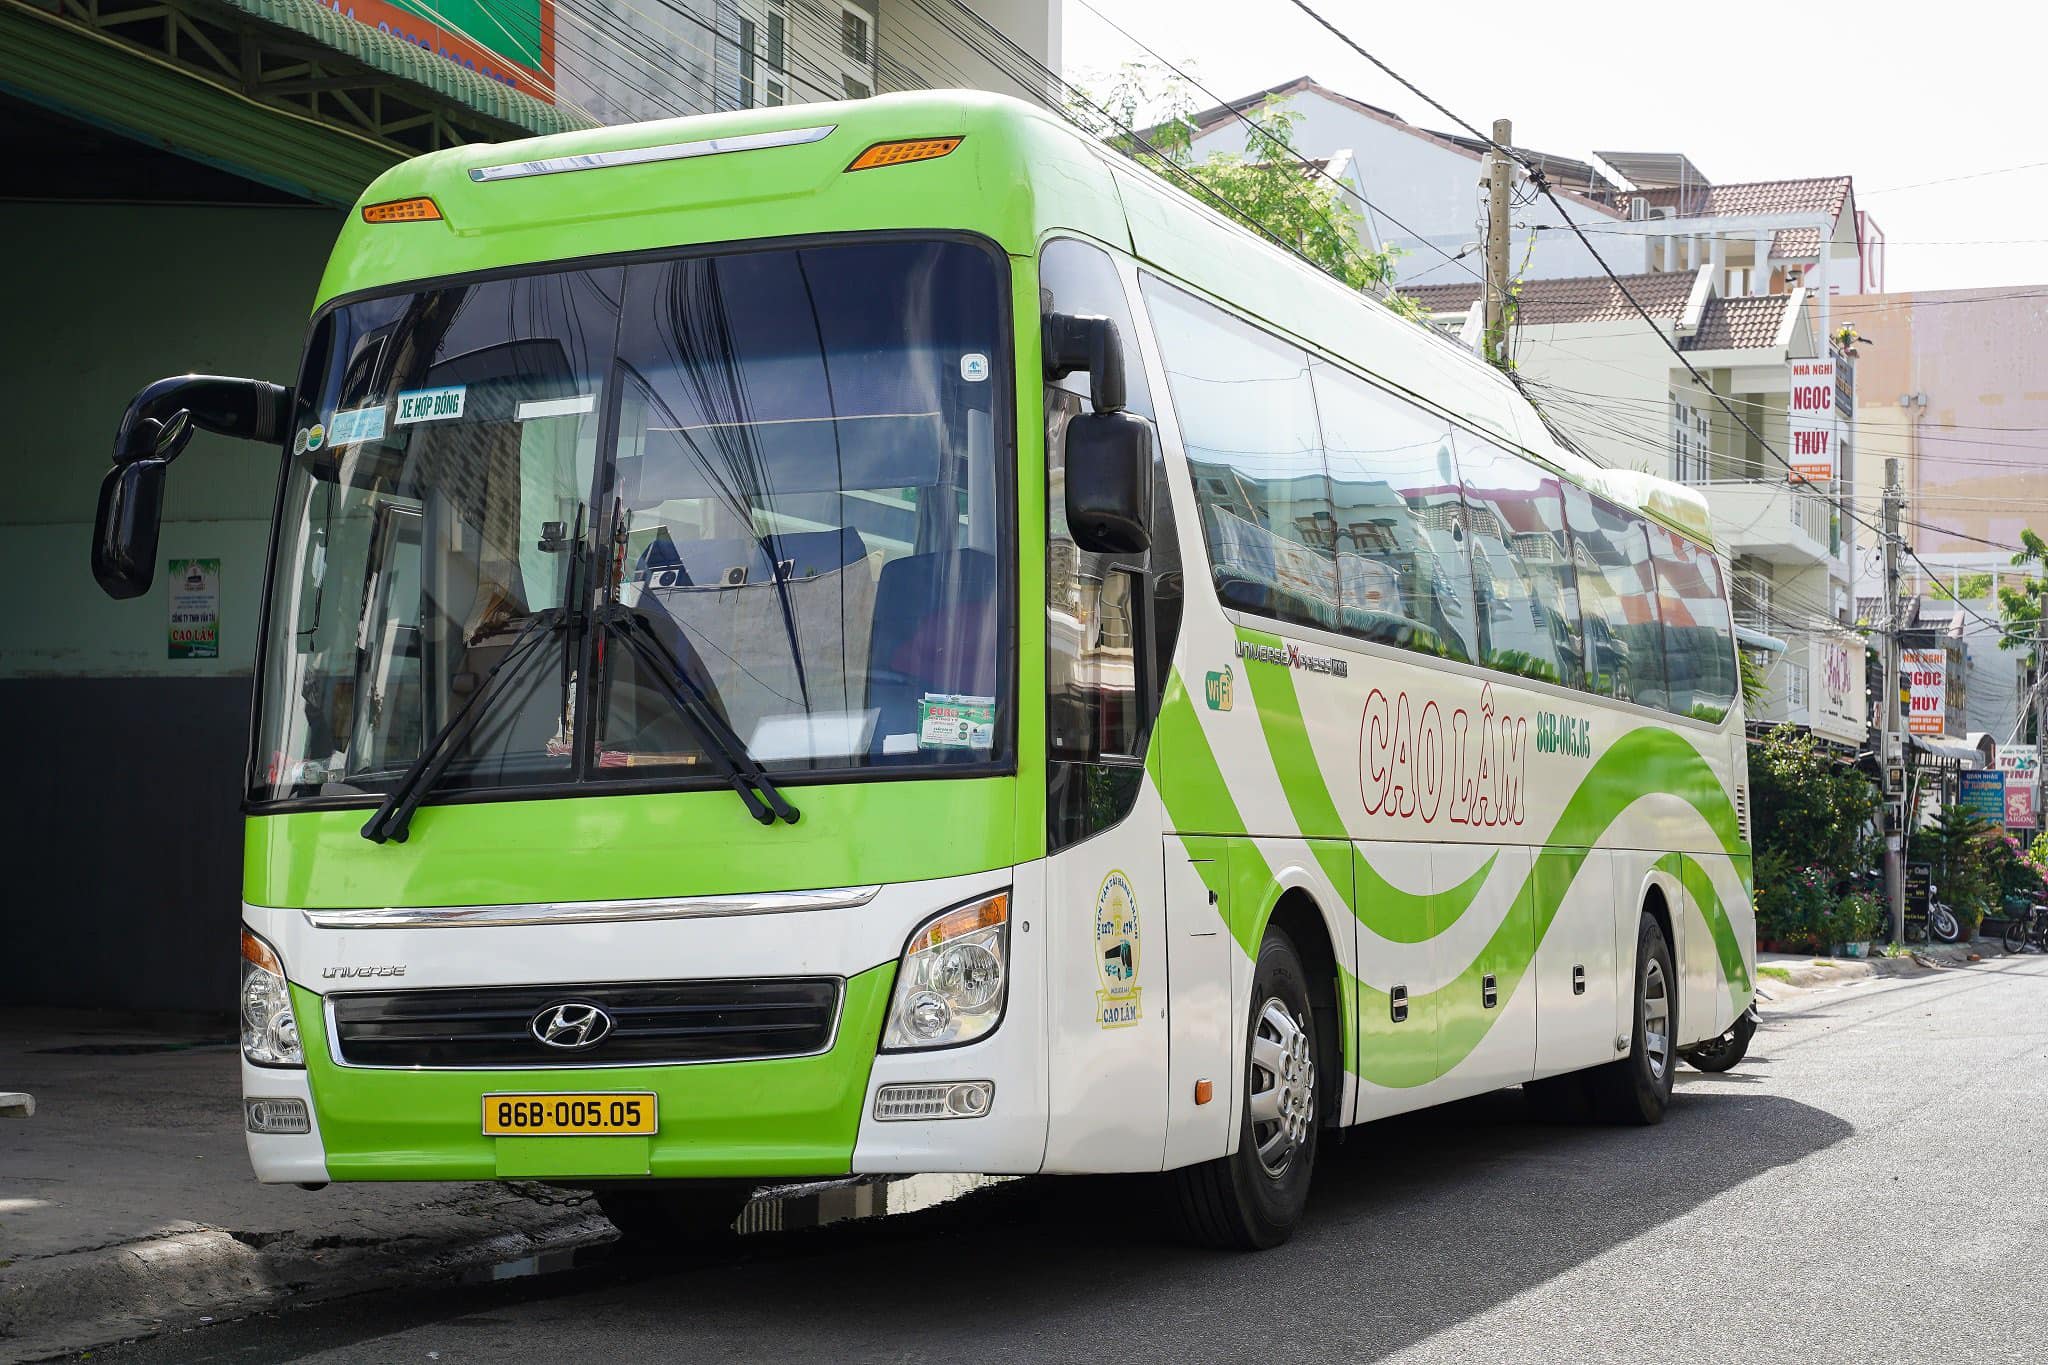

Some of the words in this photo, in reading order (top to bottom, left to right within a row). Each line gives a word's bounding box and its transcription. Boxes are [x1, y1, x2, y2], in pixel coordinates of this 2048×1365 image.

[400, 399, 414, 419] XE
[1793, 386, 1831, 414] NGỌC
[172, 630, 192, 641] CAO
[1536, 710, 1591, 760] 86B-005.05
[1359, 688, 1444, 824] CAO
[1449, 681, 1527, 827] LÂM
[322, 964, 407, 979] UNIVERSE
[1103, 1007, 1119, 1023] CAO
[1120, 1001, 1137, 1022] LÂM
[498, 1101, 641, 1127] 86B-005.05
